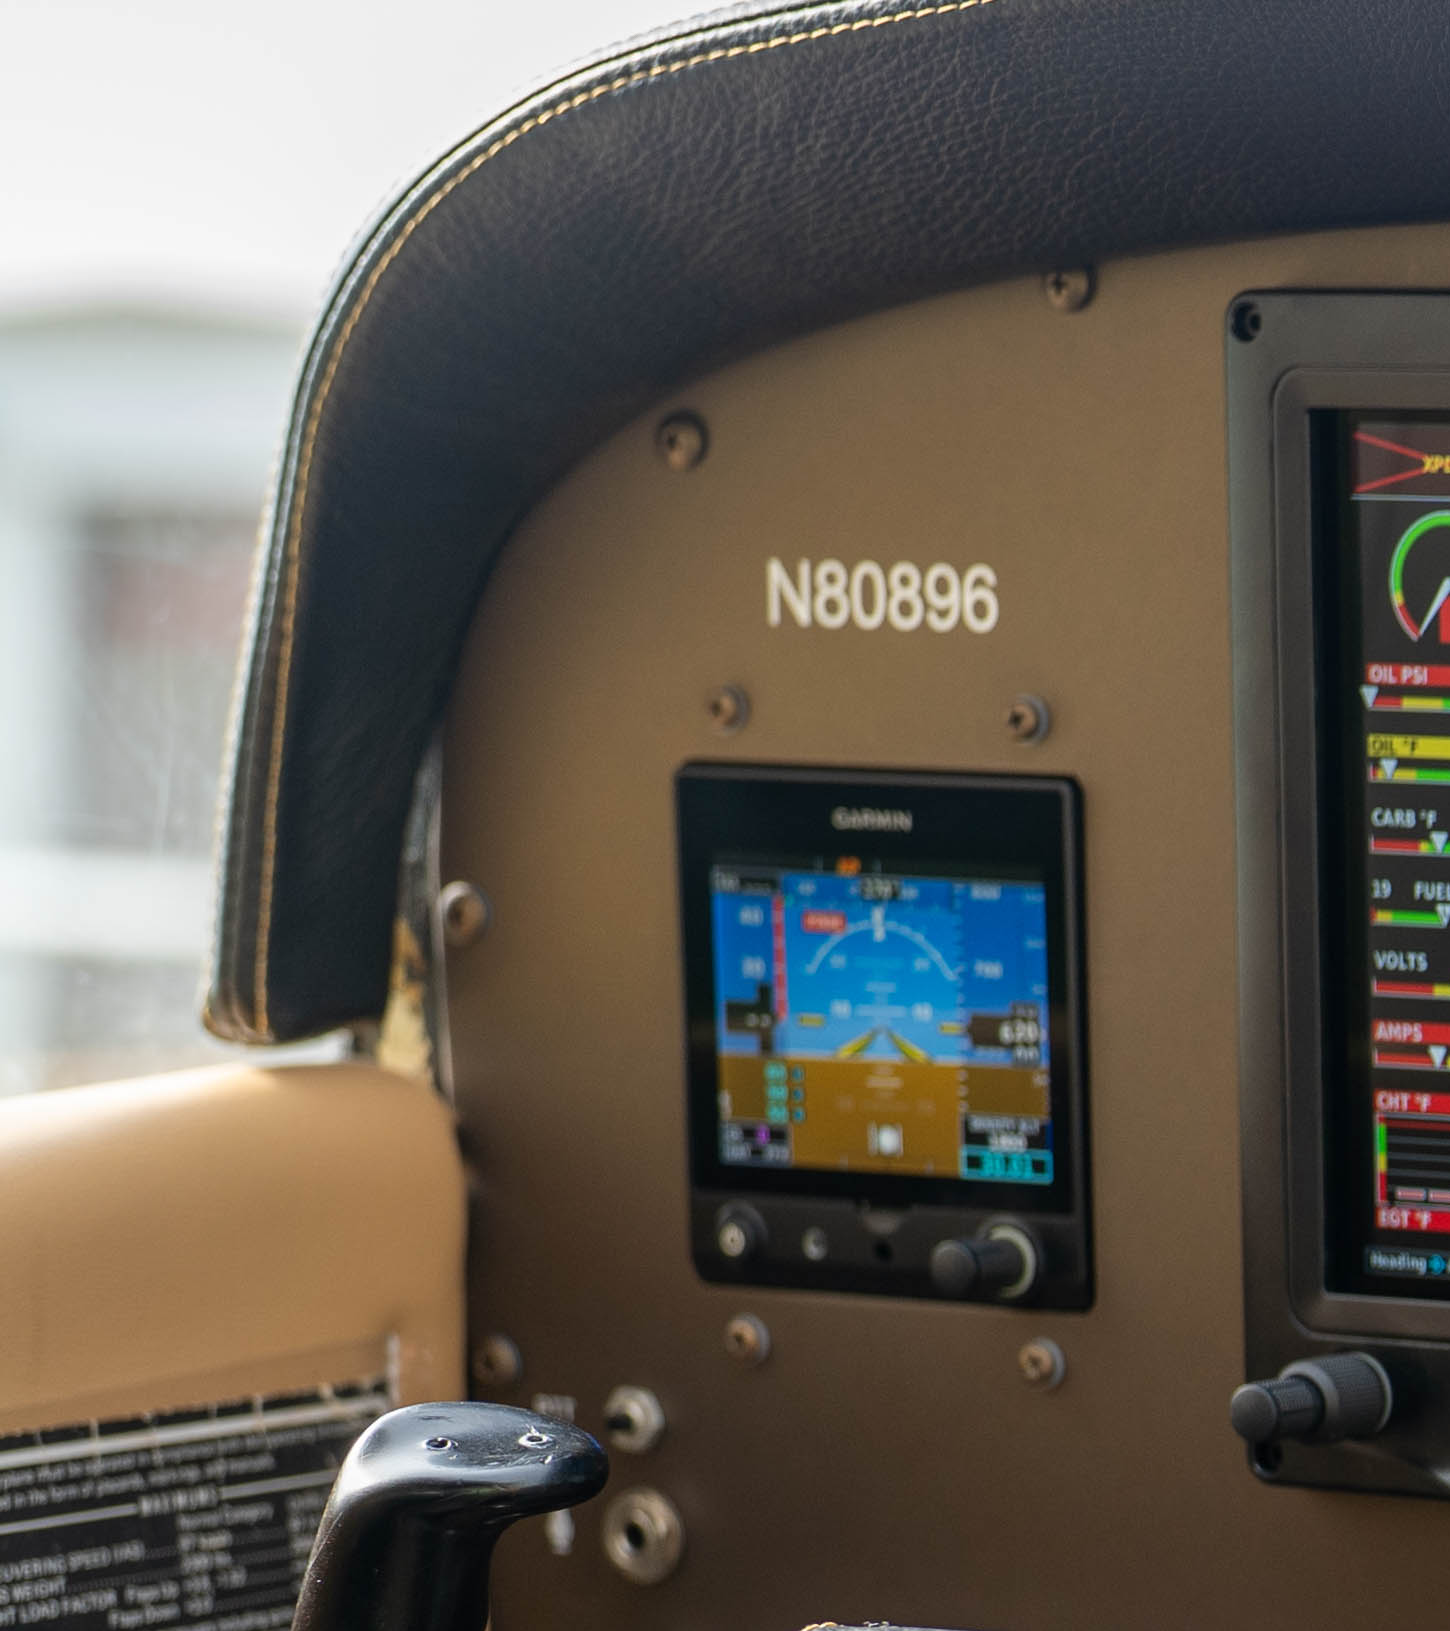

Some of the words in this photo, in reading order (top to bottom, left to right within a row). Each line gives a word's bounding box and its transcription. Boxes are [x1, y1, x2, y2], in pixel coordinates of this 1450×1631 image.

[767, 556, 999, 634] N80896
[1368, 665, 1397, 684] OIL
[1401, 666, 1428, 685] PSI
[831, 806, 913, 832] GARMIN
[1371, 808, 1416, 829] CARB
[1375, 951, 1427, 972] VOLTS
[1375, 1024, 1423, 1043] AMPS
[1376, 1092, 1411, 1111] CHT
[1370, 1252, 1427, 1276] Heading
